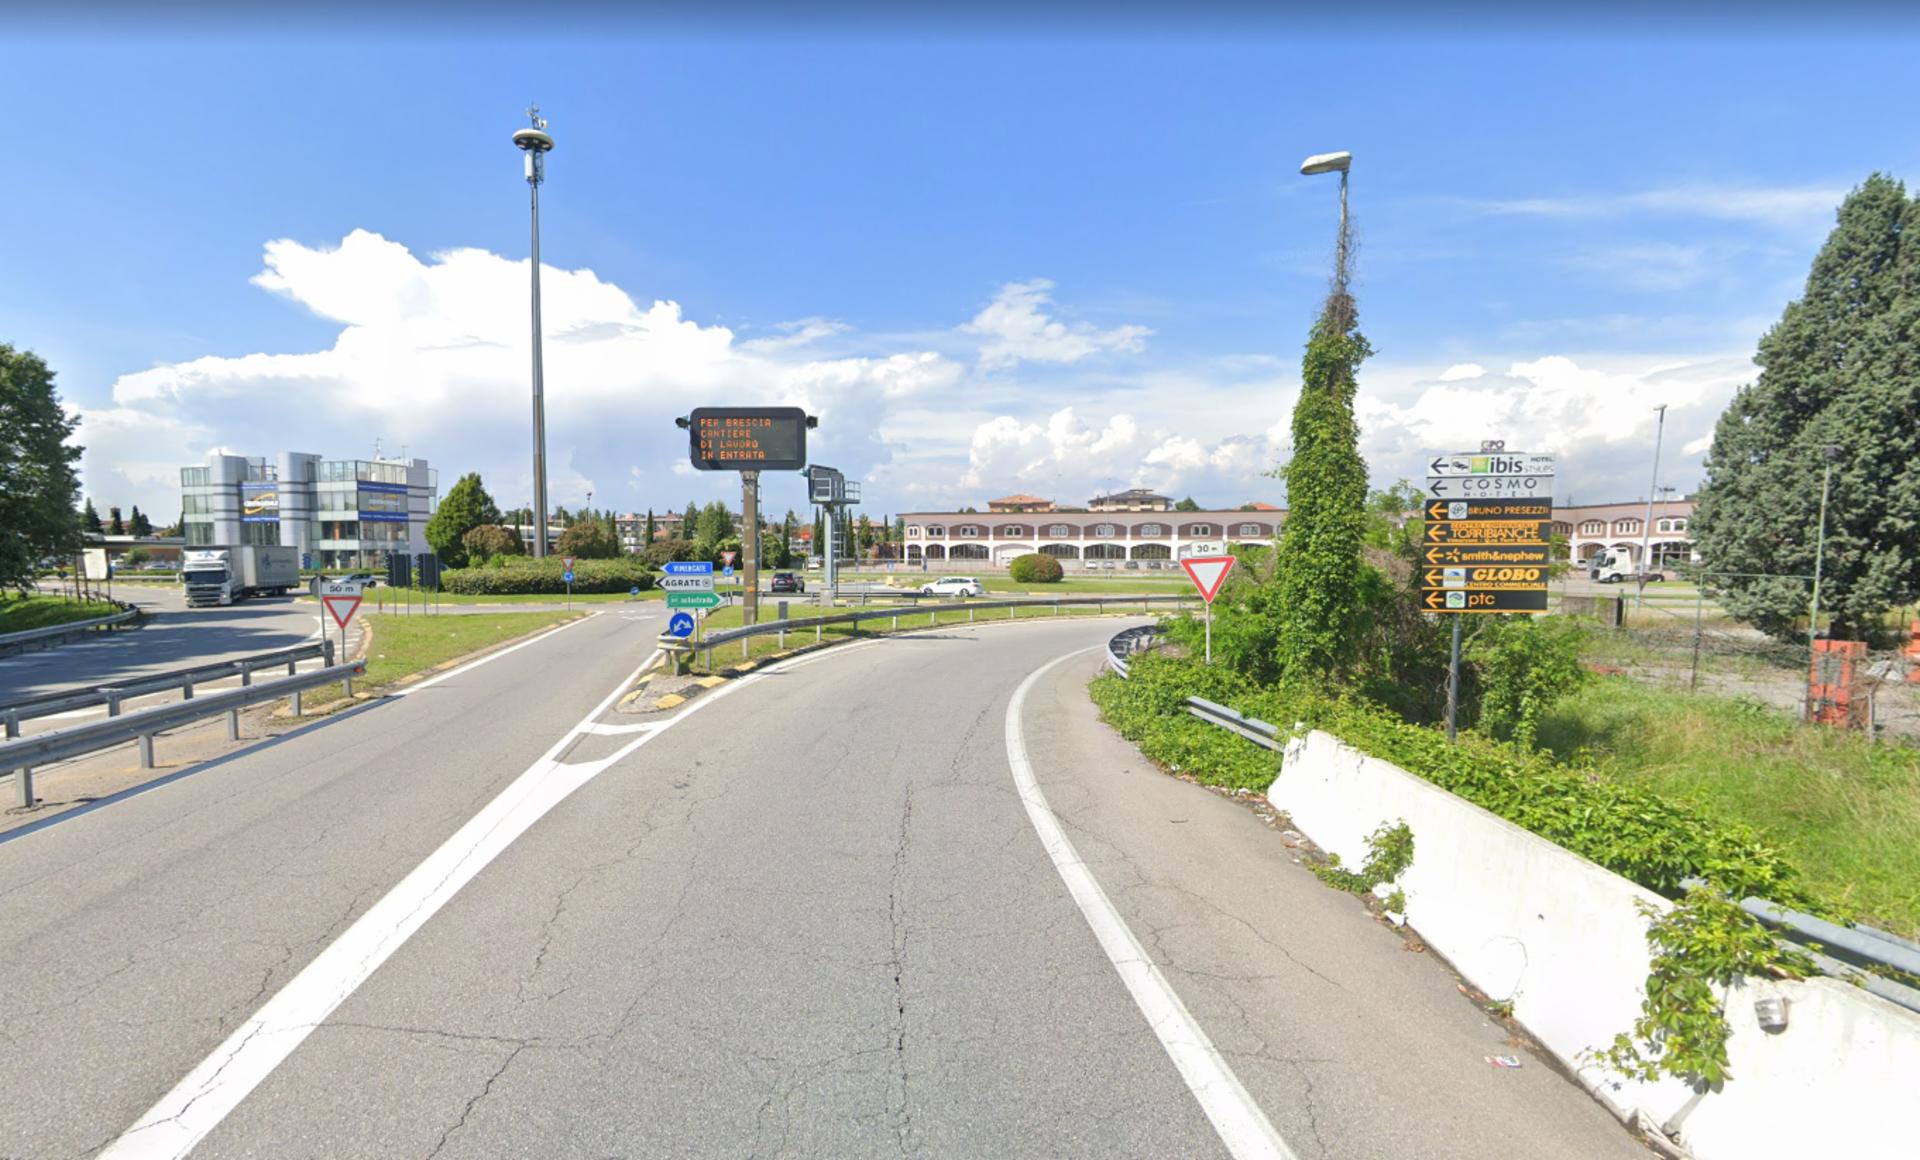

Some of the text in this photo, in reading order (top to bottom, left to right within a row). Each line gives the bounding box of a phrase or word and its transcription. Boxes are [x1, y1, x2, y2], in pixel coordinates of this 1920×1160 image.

[700, 418, 772, 427] PER BRESCIA
[700, 429, 751, 438] CANTIERE
[700, 440, 759, 448] DI LAVORO
[701, 450, 765, 459] IN ENTRATA
[1490, 457, 1523, 473] ibis
[1462, 478, 1537, 490] COSMO
[1468, 506, 1502, 515] BRUNO
[1462, 551, 1544, 563] smith&nephew
[1472, 568, 1540, 581] GLOBO
[329, 584, 342, 593] 50
[1468, 593, 1495, 607] ptc
